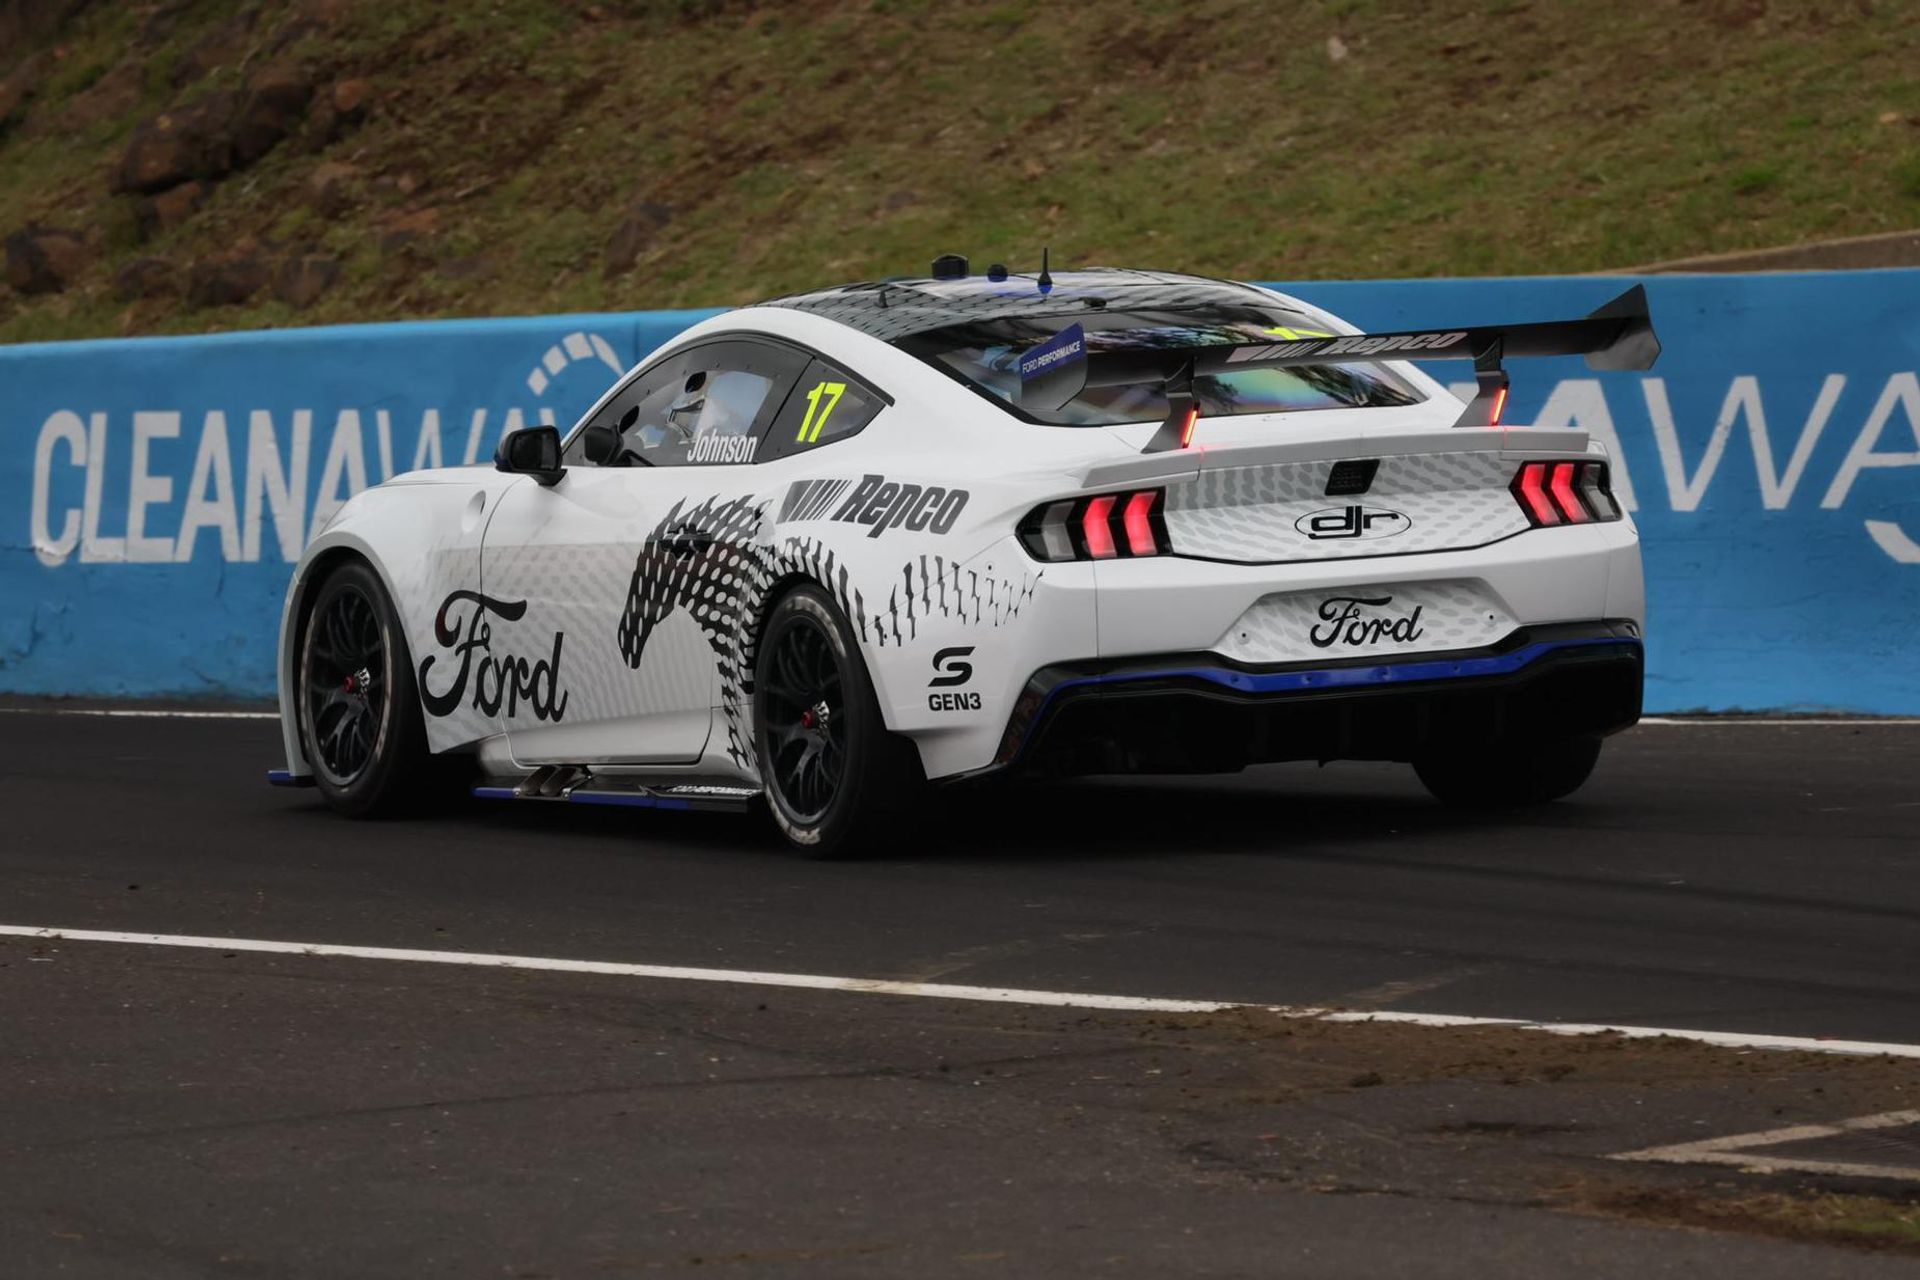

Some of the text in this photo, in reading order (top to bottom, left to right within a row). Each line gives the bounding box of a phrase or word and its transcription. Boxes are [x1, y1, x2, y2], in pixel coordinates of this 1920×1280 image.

[1022, 340, 1081, 374] FORD PERFORMANCE
[796, 381, 846, 442] 17
[686, 428, 758, 463] Johnson
[30, 408, 557, 567] CLEANA
[1309, 596, 1424, 648] Ford
[419, 589, 569, 723] Ford
[928, 692, 982, 712] GEN3
